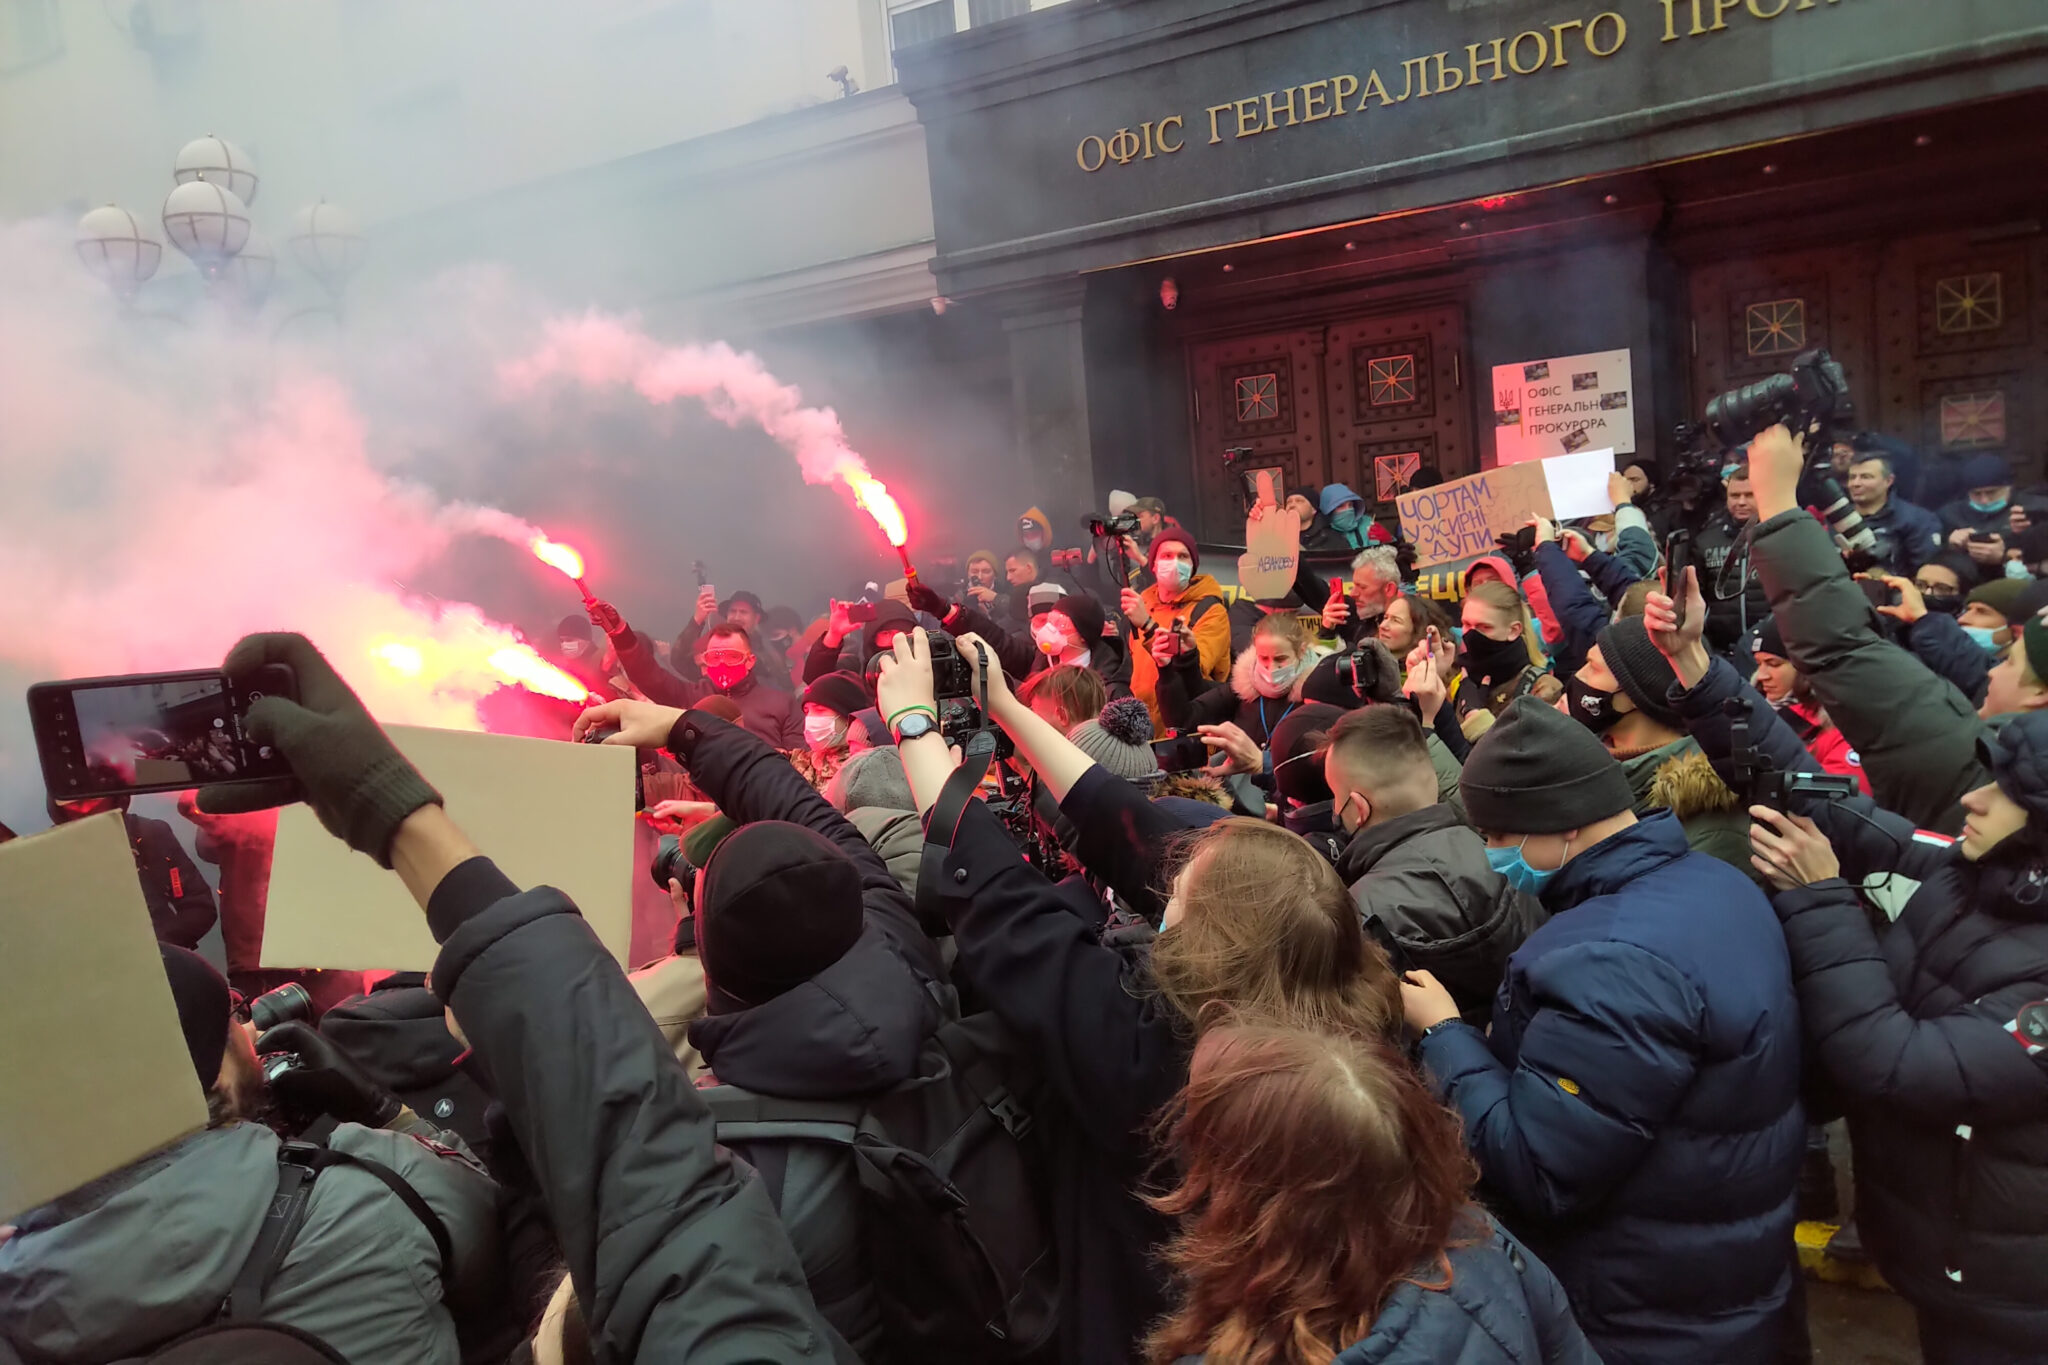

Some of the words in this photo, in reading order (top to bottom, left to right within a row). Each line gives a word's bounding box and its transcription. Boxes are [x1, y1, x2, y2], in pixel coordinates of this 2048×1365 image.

[1077, 115, 1184, 172] ОФІС
[1206, 12, 1627, 145] ГЕНЕРАЛЬНОГО
[1527, 385, 1563, 399] ОФІС
[1528, 400, 1602, 417] ГЕНЕРАЛЬН
[1529, 418, 1607, 436] ПРОКУРОРА
[1401, 477, 1492, 522] ЧОРТАМ
[1429, 528, 1494, 561] ДУПИ
